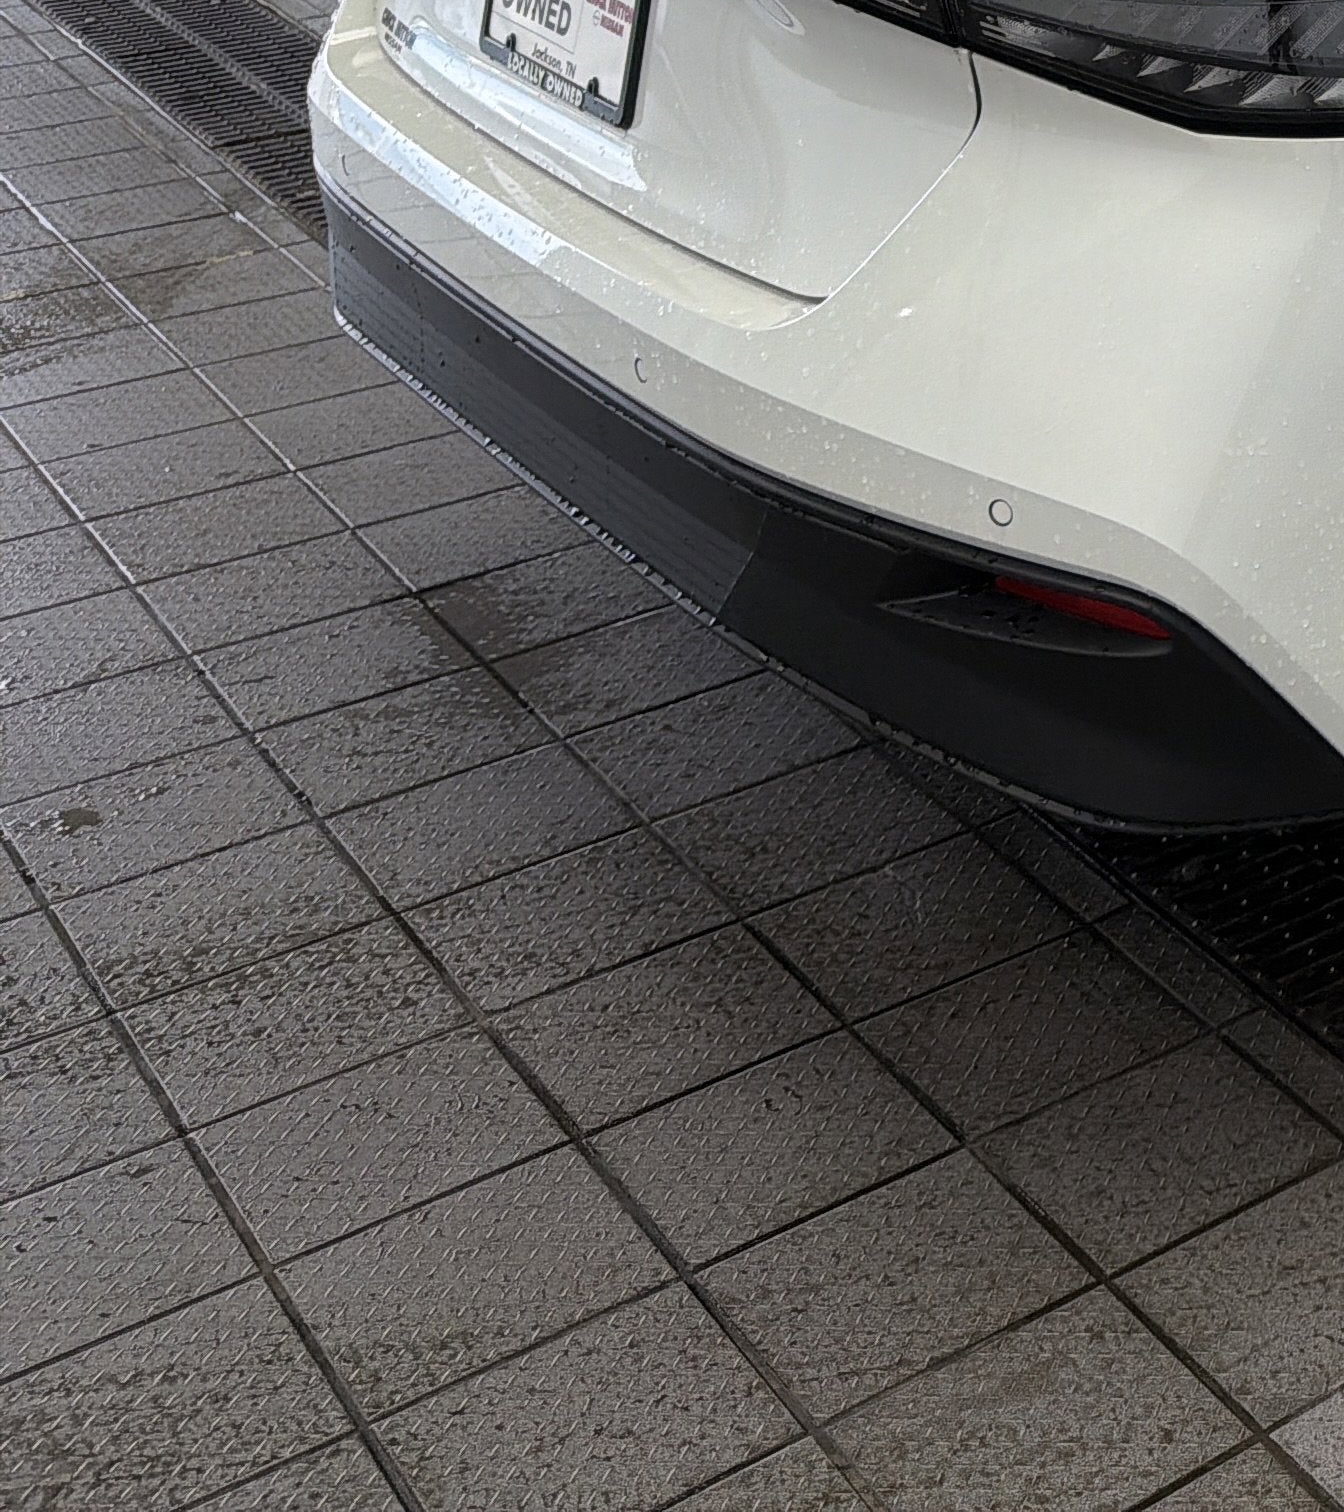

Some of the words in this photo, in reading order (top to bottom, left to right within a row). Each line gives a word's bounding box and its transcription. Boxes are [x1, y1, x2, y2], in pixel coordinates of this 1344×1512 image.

[507, 51, 546, 86] LOCALLY
[546, 70, 583, 107] OWNED
[531, 42, 563, 73] Jackson,
[565, 60, 577, 79] TN
